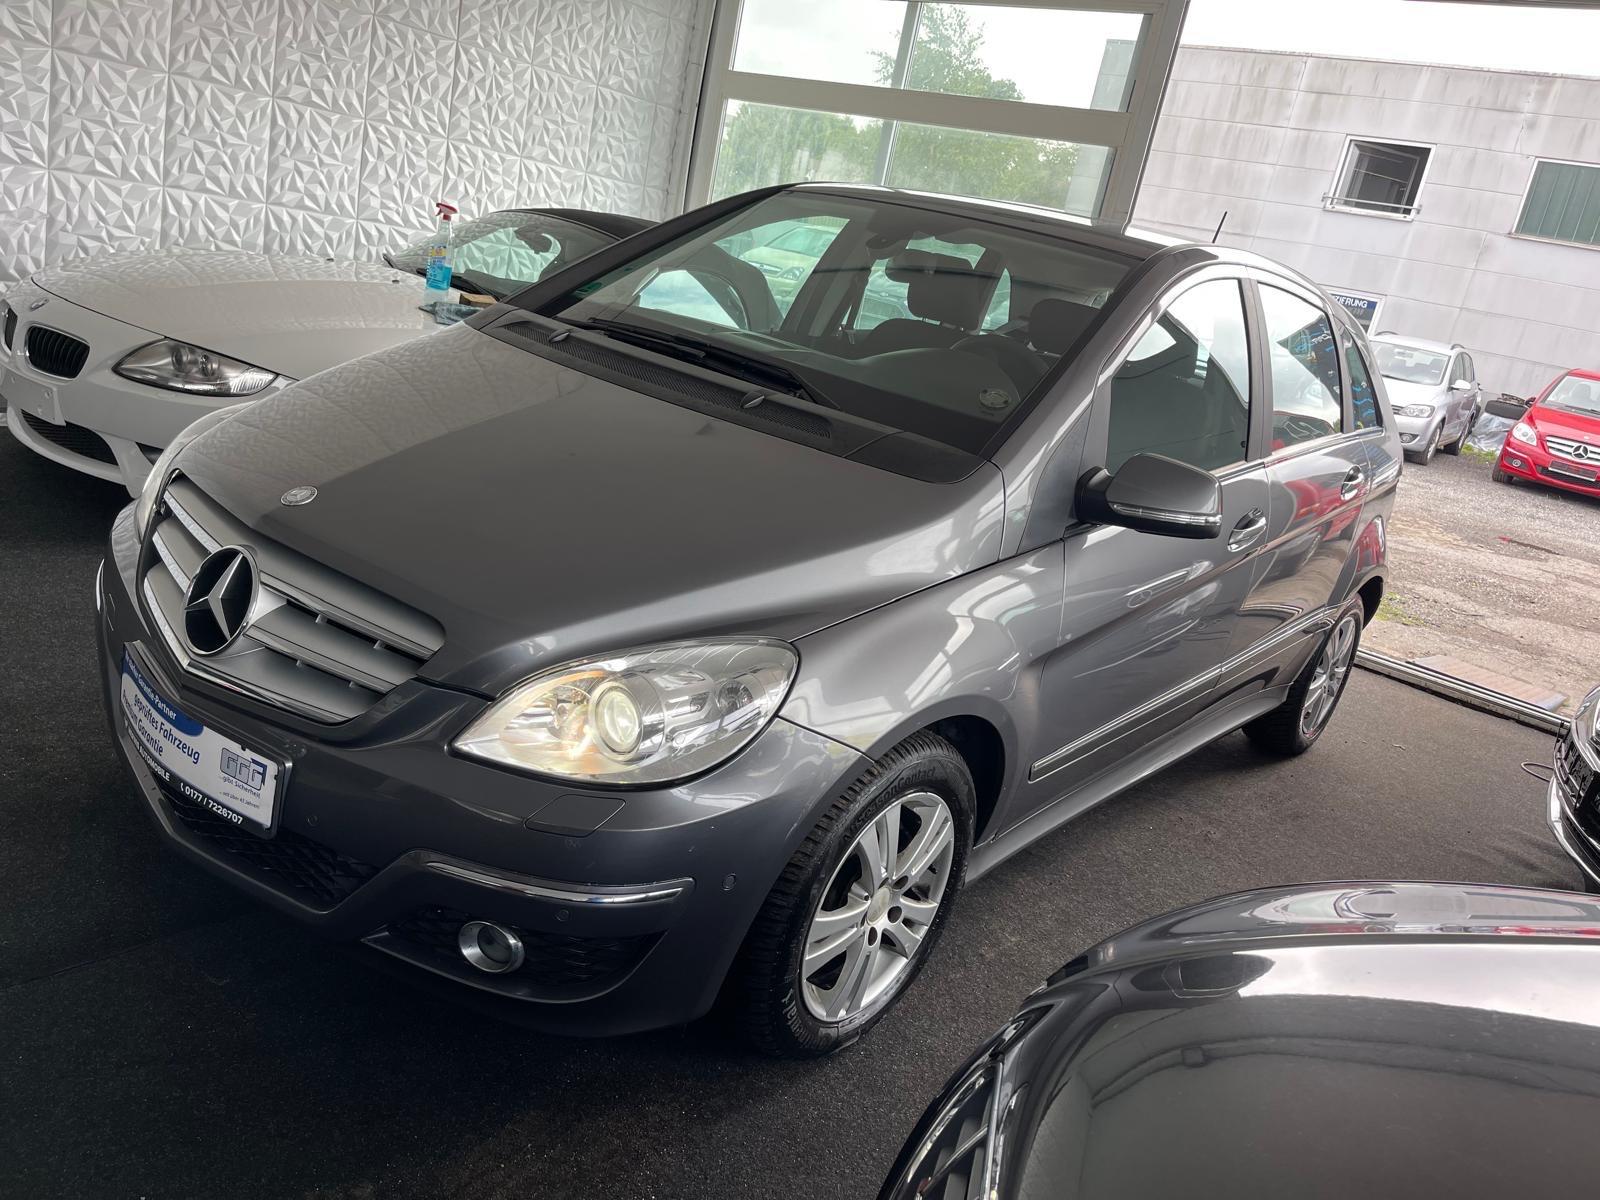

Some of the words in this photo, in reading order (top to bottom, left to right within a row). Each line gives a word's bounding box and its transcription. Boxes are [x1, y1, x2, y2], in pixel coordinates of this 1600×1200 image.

[134, 693, 159, 730] geprüftes
[158, 722, 201, 765] Fahrzeug
[137, 720, 164, 757] Garantie
[138, 745, 171, 782] AUTOMOBILE
[184, 787, 203, 803] 0177
